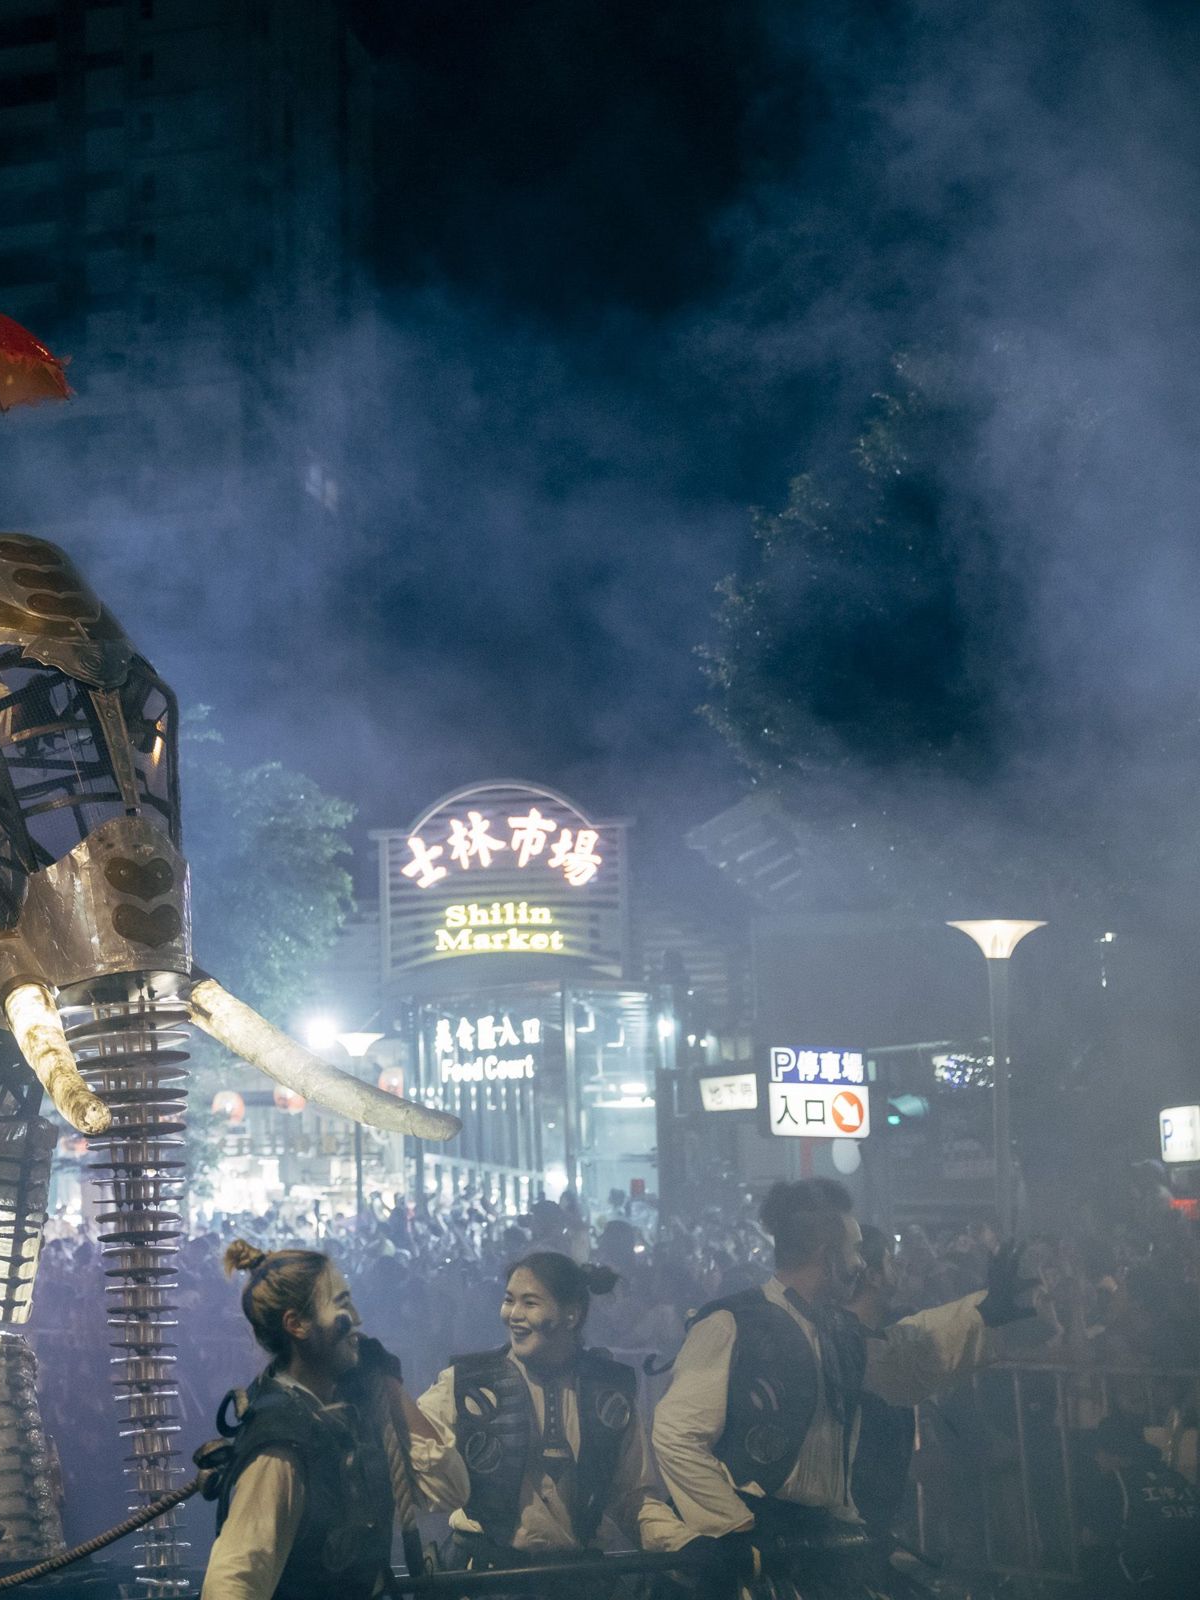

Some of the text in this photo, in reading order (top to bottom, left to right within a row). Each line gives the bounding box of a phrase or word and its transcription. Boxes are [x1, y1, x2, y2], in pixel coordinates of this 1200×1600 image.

[401, 808, 602, 889] 士林市場
[445, 902, 553, 928] Shilin
[435, 928, 564, 951] Market
[441, 1055, 535, 1083] Food Court
[776, 1095, 826, 1125] 入口
